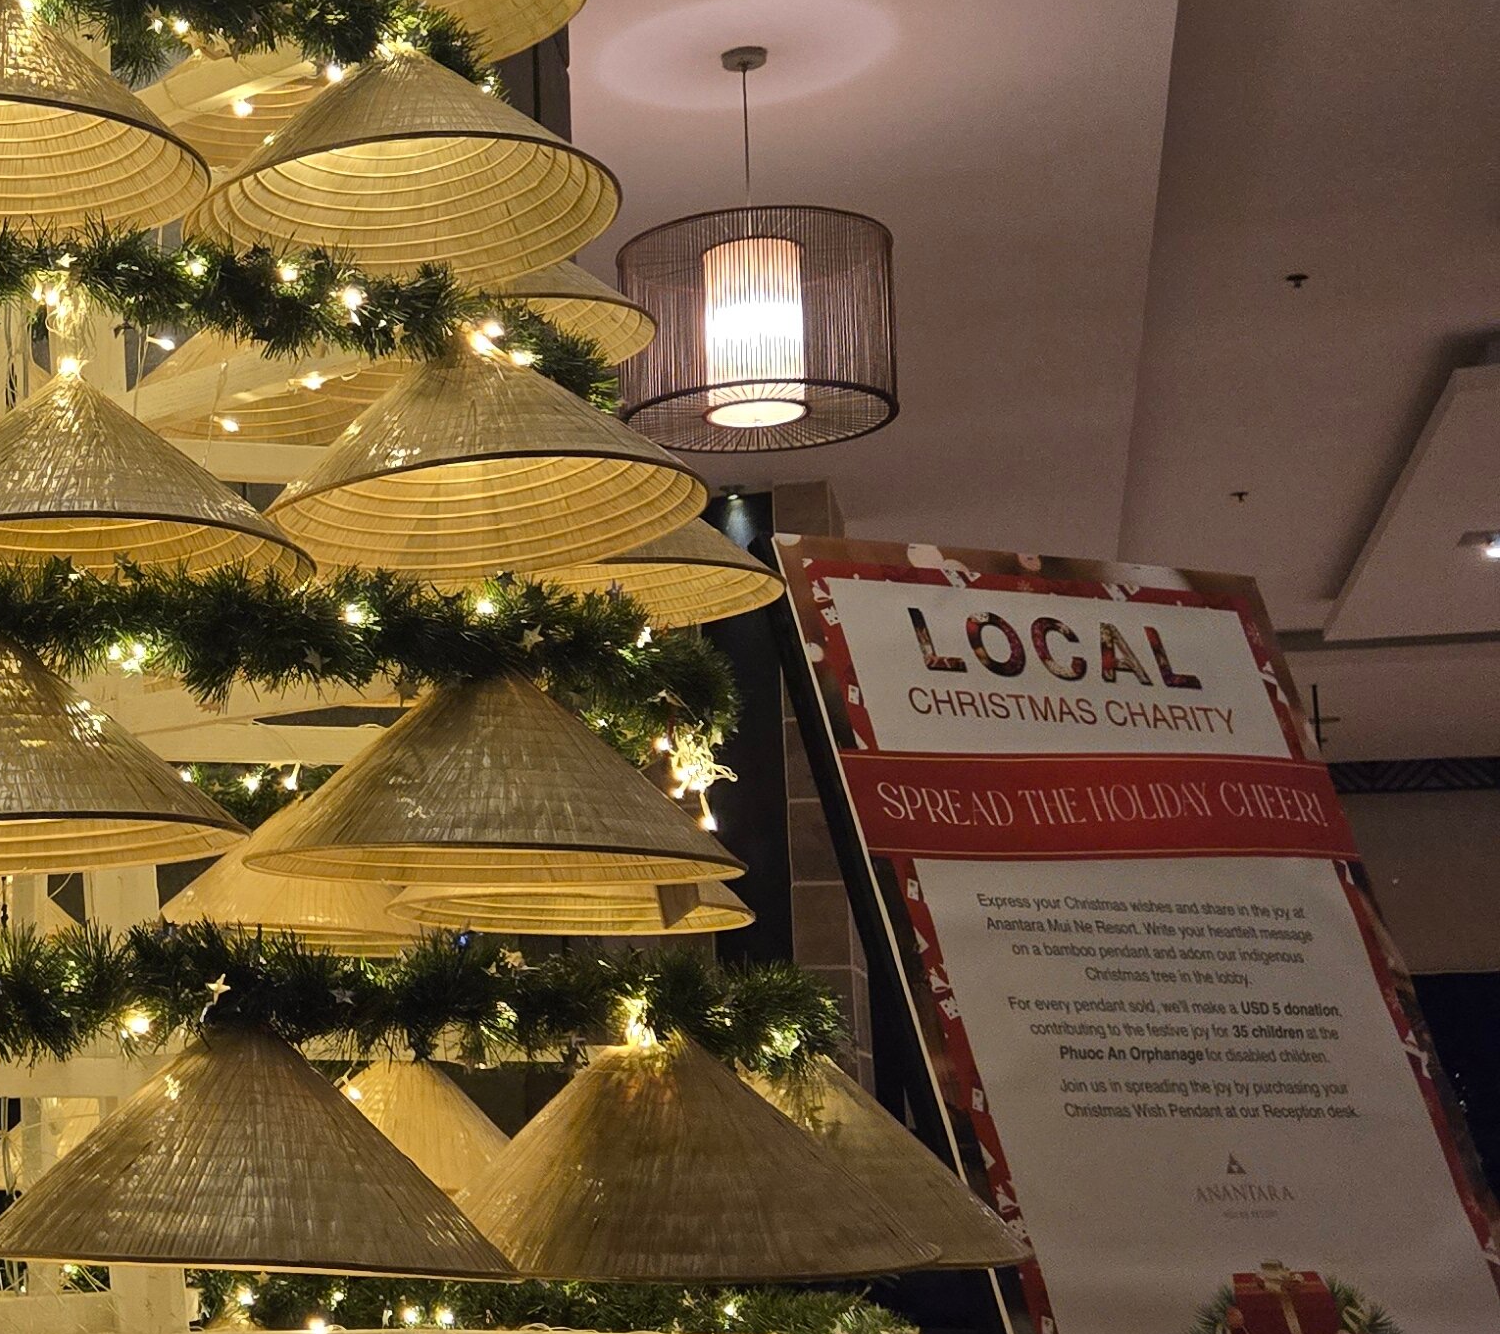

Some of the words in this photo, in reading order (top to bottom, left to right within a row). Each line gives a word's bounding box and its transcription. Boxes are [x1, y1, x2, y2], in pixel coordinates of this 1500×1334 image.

[907, 606, 1202, 690] LOCAL
[908, 687, 1097, 725] CHRISTMAS
[1106, 700, 1236, 735] CHARITY
[877, 782, 1013, 826] SPREAD
[1019, 787, 1087, 825] THE
[1089, 782, 1213, 823] HOLIDAY
[1220, 781, 1328, 827] CHEER!
[977, 893, 1030, 909] Express
[1033, 898, 1060, 911] your
[1064, 896, 1126, 911] Christmas
[1130, 900, 1172, 913] wishes
[1176, 902, 1199, 914] and
[1201, 903, 1235, 916] share
[1239, 904, 1249, 916] in
[1251, 904, 1270, 917] the
[1273, 906, 1289, 920] joy
[1293, 907, 1305, 918] at
[987, 917, 1043, 932] Anantara
[1047, 919, 1071, 933] Mui
[1074, 921, 1093, 933] Ne
[1096, 921, 1140, 934] Resort.
[1143, 922, 1176, 936] Write
[1179, 925, 1204, 940] your
[1209, 925, 1257, 939] heartfelt
[1260, 929, 1313, 944] message
[1012, 943, 1029, 955] on
[1033, 946, 1042, 955] a
[1044, 943, 1096, 957] bamboo
[1099, 945, 1151, 959] pendant
[1153, 947, 1175, 959] and
[1179, 947, 1214, 960] adorn
[1217, 950, 1237, 961] our
[1240, 948, 1304, 965] indigenous
[1085, 967, 1148, 982] Christmas
[1151, 971, 1176, 983] tree
[1179, 970, 1191, 982] in
[1193, 971, 1214, 984] the
[1216, 972, 1252, 987] lobby.
[1007, 996, 1031, 1011] For
[1034, 999, 1070, 1014] every
[1074, 998, 1125, 1013] pendant
[1128, 1000, 1160, 1014] sold,
[1192, 1002, 1226, 1015] make
[1230, 1005, 1239, 1015] a
[1241, 1001, 1270, 1015] USD
[1272, 1002, 1281, 1015] 5
[1030, 1023, 1107, 1039] contributing
[1108, 1023, 1121, 1036] to
[1124, 1024, 1145, 1037] the
[1147, 1023, 1189, 1037] festive
[1191, 1025, 1211, 1040] joy
[1212, 1024, 1228, 1038] for
[1232, 1025, 1248, 1038] 35
[1251, 1025, 1304, 1039] children
[1306, 1027, 1319, 1039] at
[1320, 1027, 1339, 1040] the
[1060, 1046, 1104, 1060] Phuoc
[1108, 1047, 1126, 1060] An
[1130, 1046, 1204, 1064] Orphanage
[1205, 1048, 1222, 1060] for
[1226, 1049, 1277, 1062] disabled
[1279, 1049, 1330, 1063] children.
[1060, 1079, 1088, 1093] Join
[1092, 1081, 1107, 1093] us
[1111, 1080, 1122, 1092] in
[1126, 1080, 1188, 1097] spreading
[1190, 1080, 1211, 1093] the
[1212, 1081, 1231, 1096] joy
[1234, 1081, 1250, 1096] by
[1253, 1081, 1321, 1097] purchasing
[1322, 1084, 1348, 1097] your
[1064, 1103, 1131, 1117] Christmas
[1134, 1104, 1166, 1117] Wish
[1168, 1104, 1221, 1118] Pendant
[1226, 1105, 1237, 1117] at
[1240, 1107, 1260, 1118] our
[1263, 1104, 1324, 1121] Reception
[1196, 1183, 1294, 1203] ANANTARA
